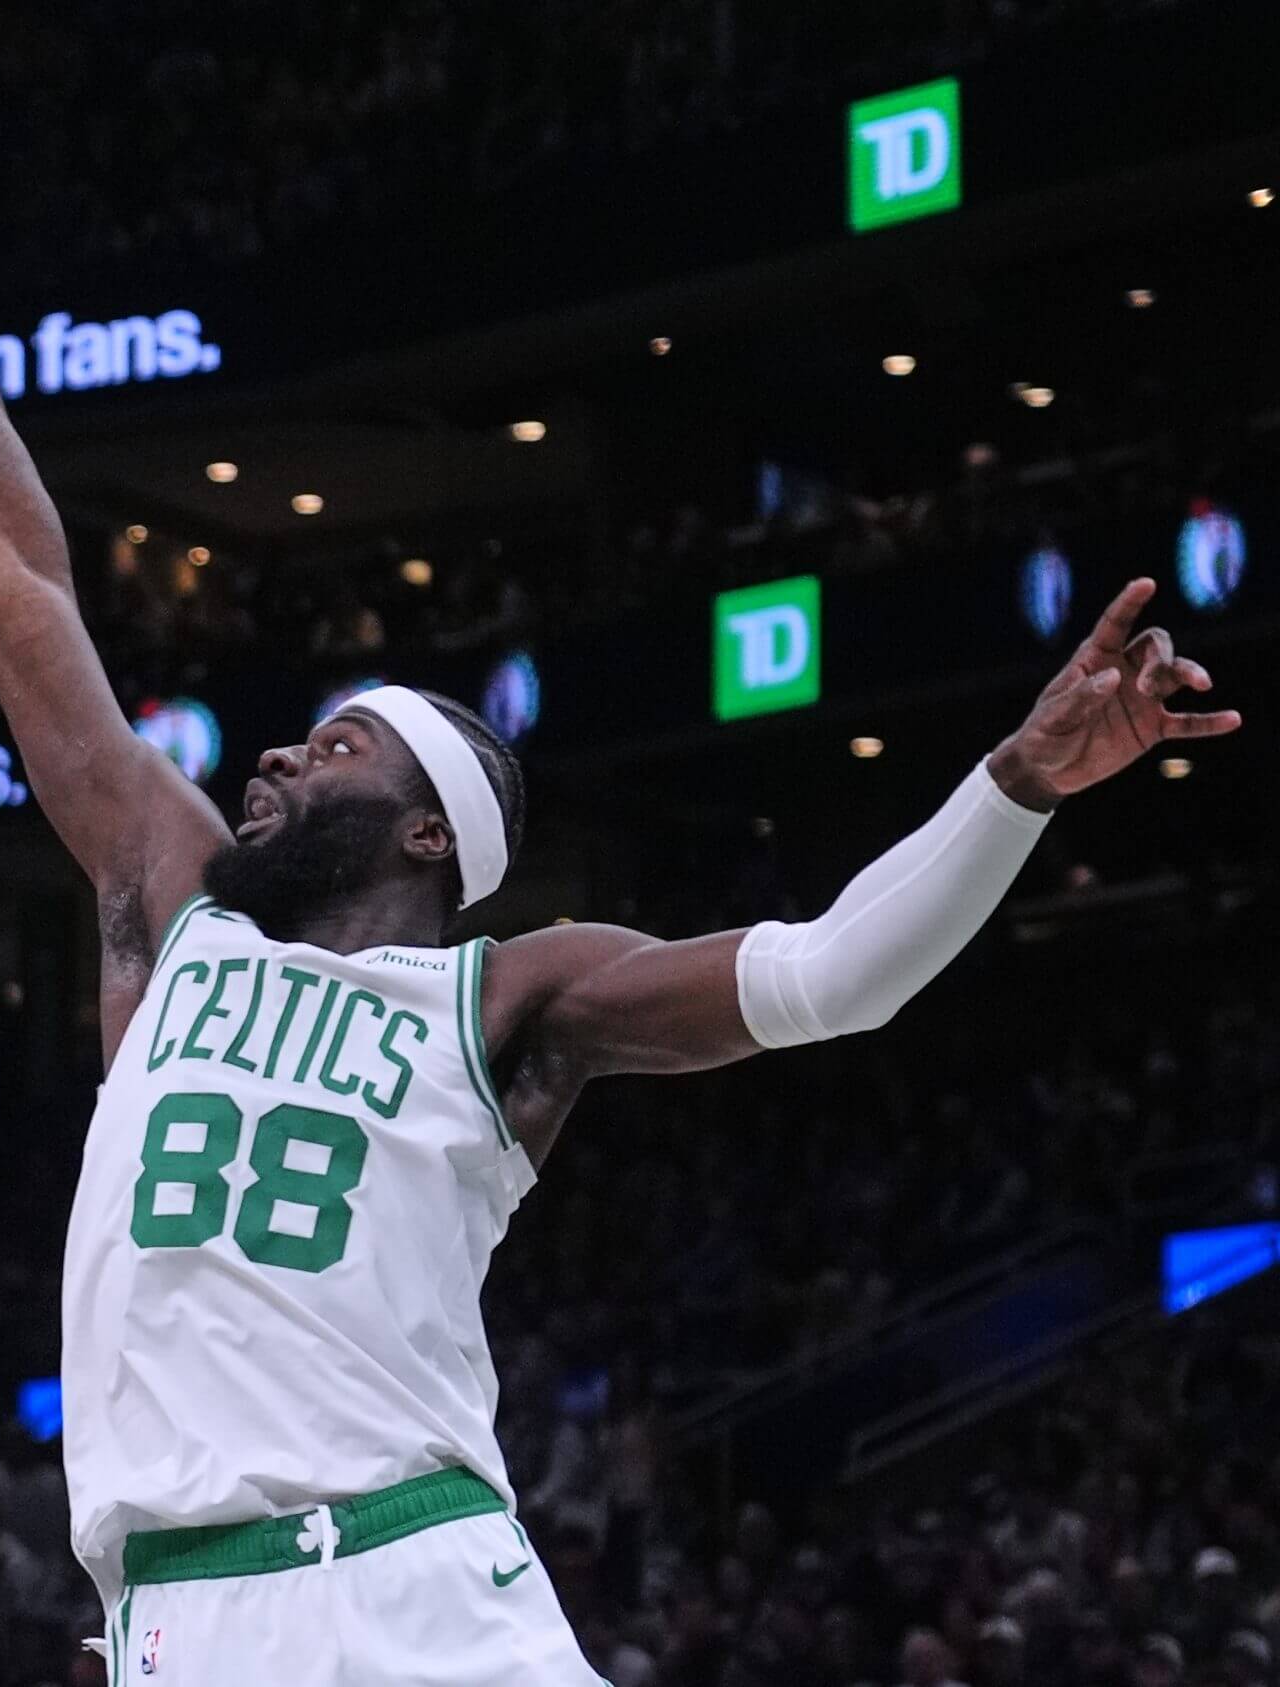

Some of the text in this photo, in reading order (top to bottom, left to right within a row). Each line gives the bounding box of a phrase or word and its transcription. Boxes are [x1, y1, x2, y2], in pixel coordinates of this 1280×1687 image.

[860, 108, 949, 198] TD
[31, 309, 222, 393] fans.
[729, 605, 808, 687] TD
[366, 951, 447, 971] Amica
[147, 959, 429, 1119] CELTICS
[130, 1092, 368, 1273] 88
